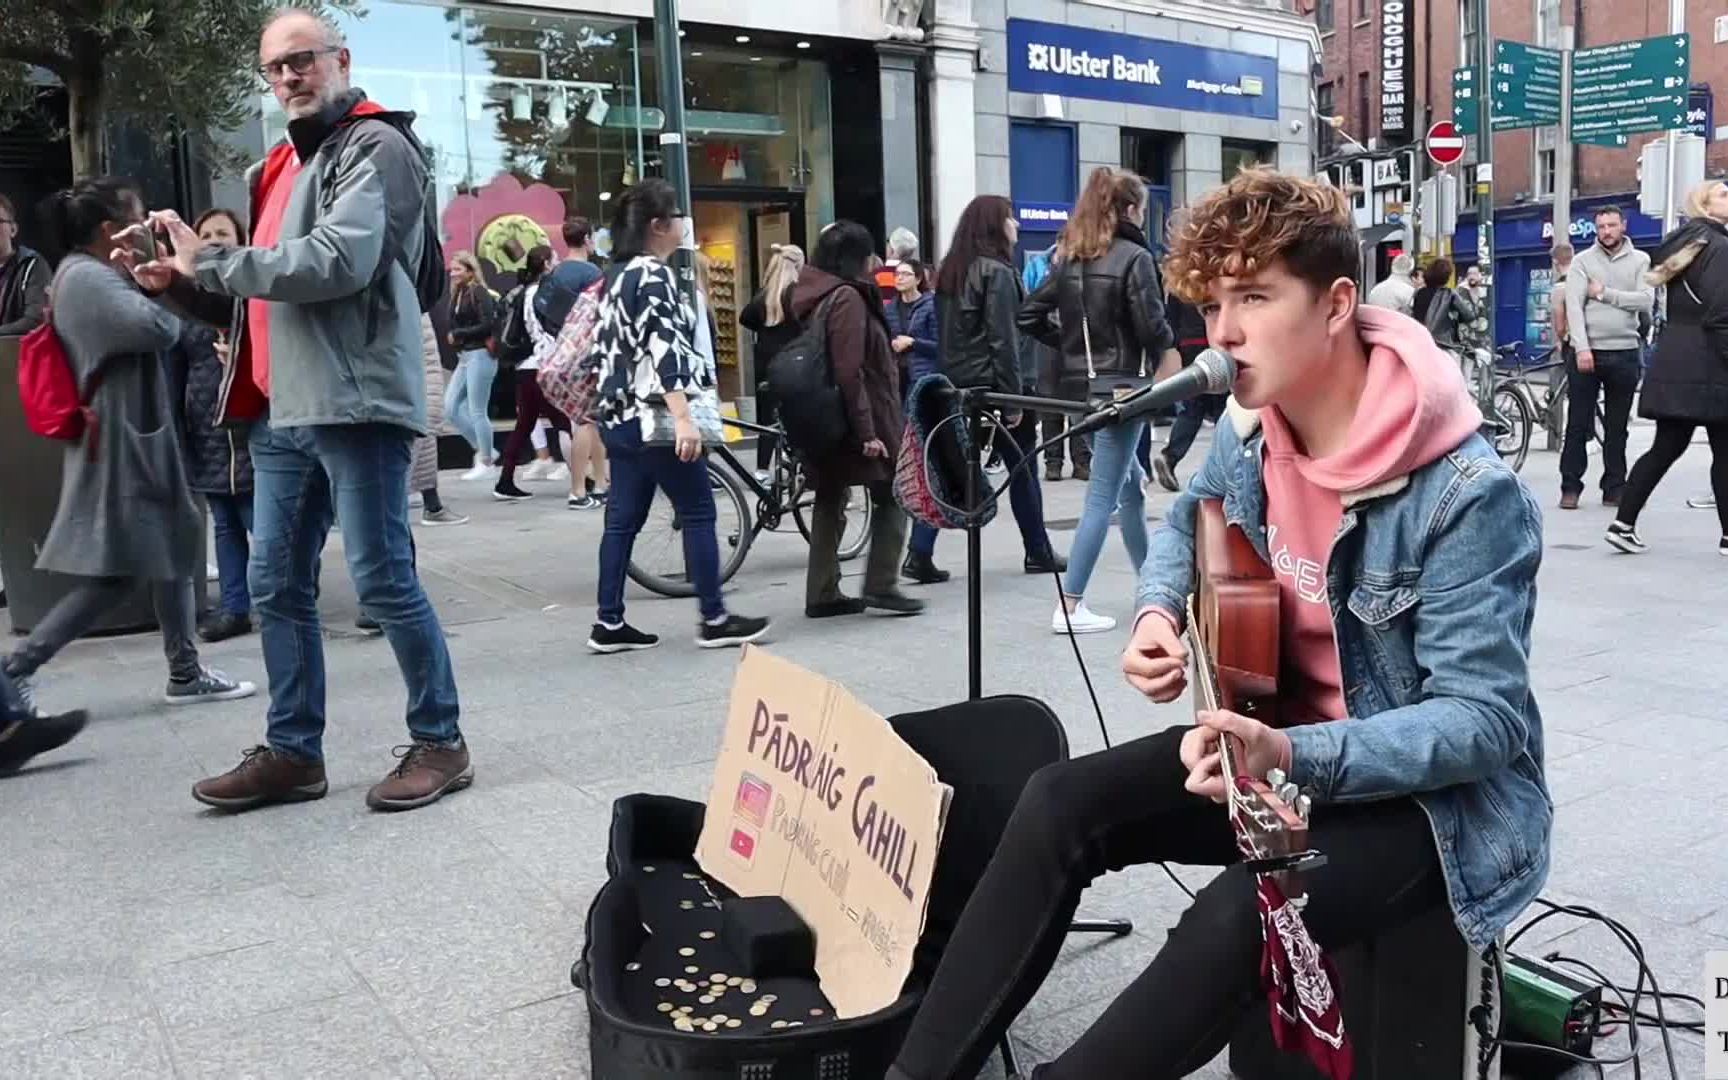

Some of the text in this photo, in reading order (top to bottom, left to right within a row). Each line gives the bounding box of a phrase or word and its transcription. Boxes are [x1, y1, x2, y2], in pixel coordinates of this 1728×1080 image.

[1050, 46, 1161, 85] Ulster Bank
[1382, 93, 1405, 105] BAR
[851, 775, 918, 903] CAHILL
